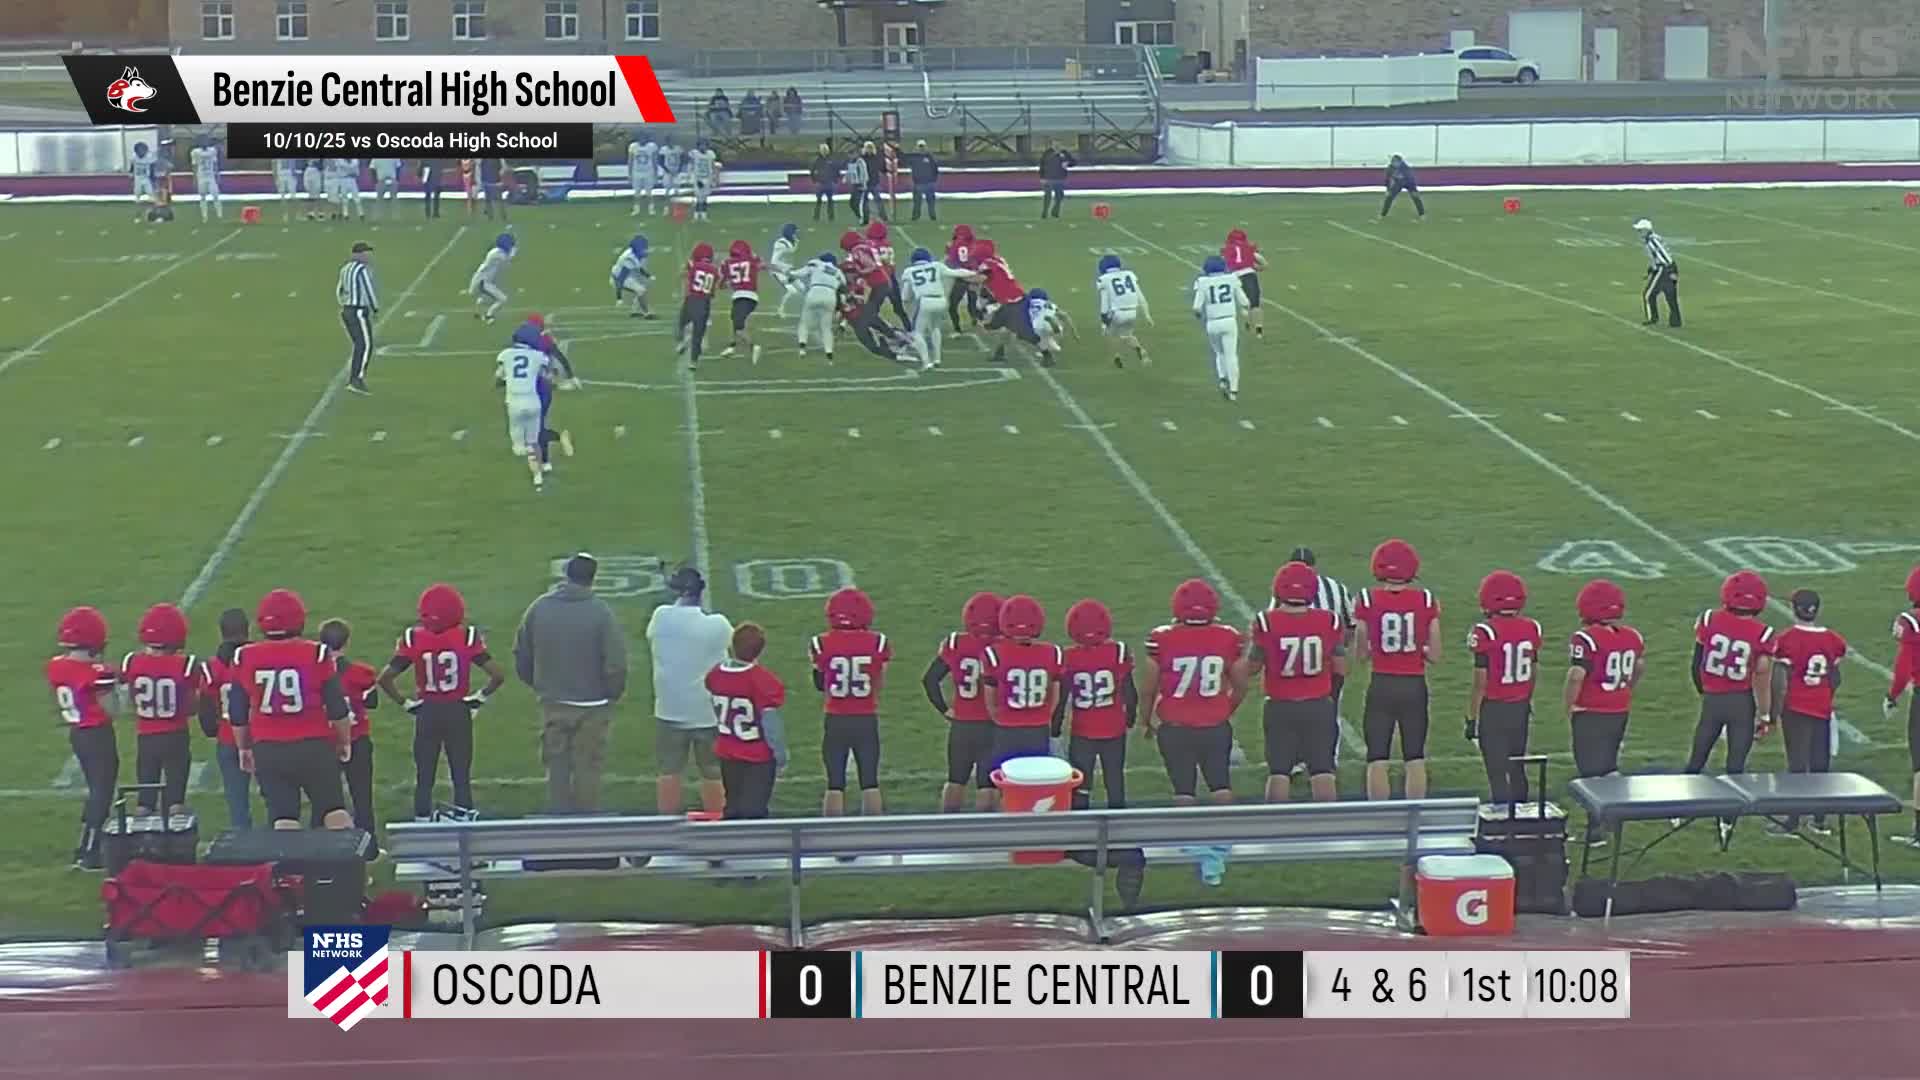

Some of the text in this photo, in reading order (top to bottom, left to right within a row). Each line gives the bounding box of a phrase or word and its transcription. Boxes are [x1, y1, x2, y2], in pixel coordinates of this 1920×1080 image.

[729, 261, 751, 284] 57
[1234, 246, 1243, 263] 1
[693, 270, 715, 294] 50
[911, 267, 937, 286] 57
[1112, 275, 1136, 296] 64
[1209, 284, 1232, 305] 12
[513, 355, 529, 379] 2
[1380, 612, 1417, 653] 81
[421, 650, 460, 692] 13
[829, 655, 873, 698] 35
[1171, 656, 1225, 698] 78
[1279, 635, 1323, 677] 70
[1502, 640, 1534, 684] 16
[1601, 649, 1636, 692] 99
[1705, 633, 1752, 682] 23
[134, 676, 177, 720] 20
[255, 668, 304, 715] 79
[958, 657, 985, 700] 3
[1007, 668, 1049, 710] 38
[1073, 669, 1116, 710] 32
[712, 695, 760, 742] 72
[1456, 889, 1489, 926] G
